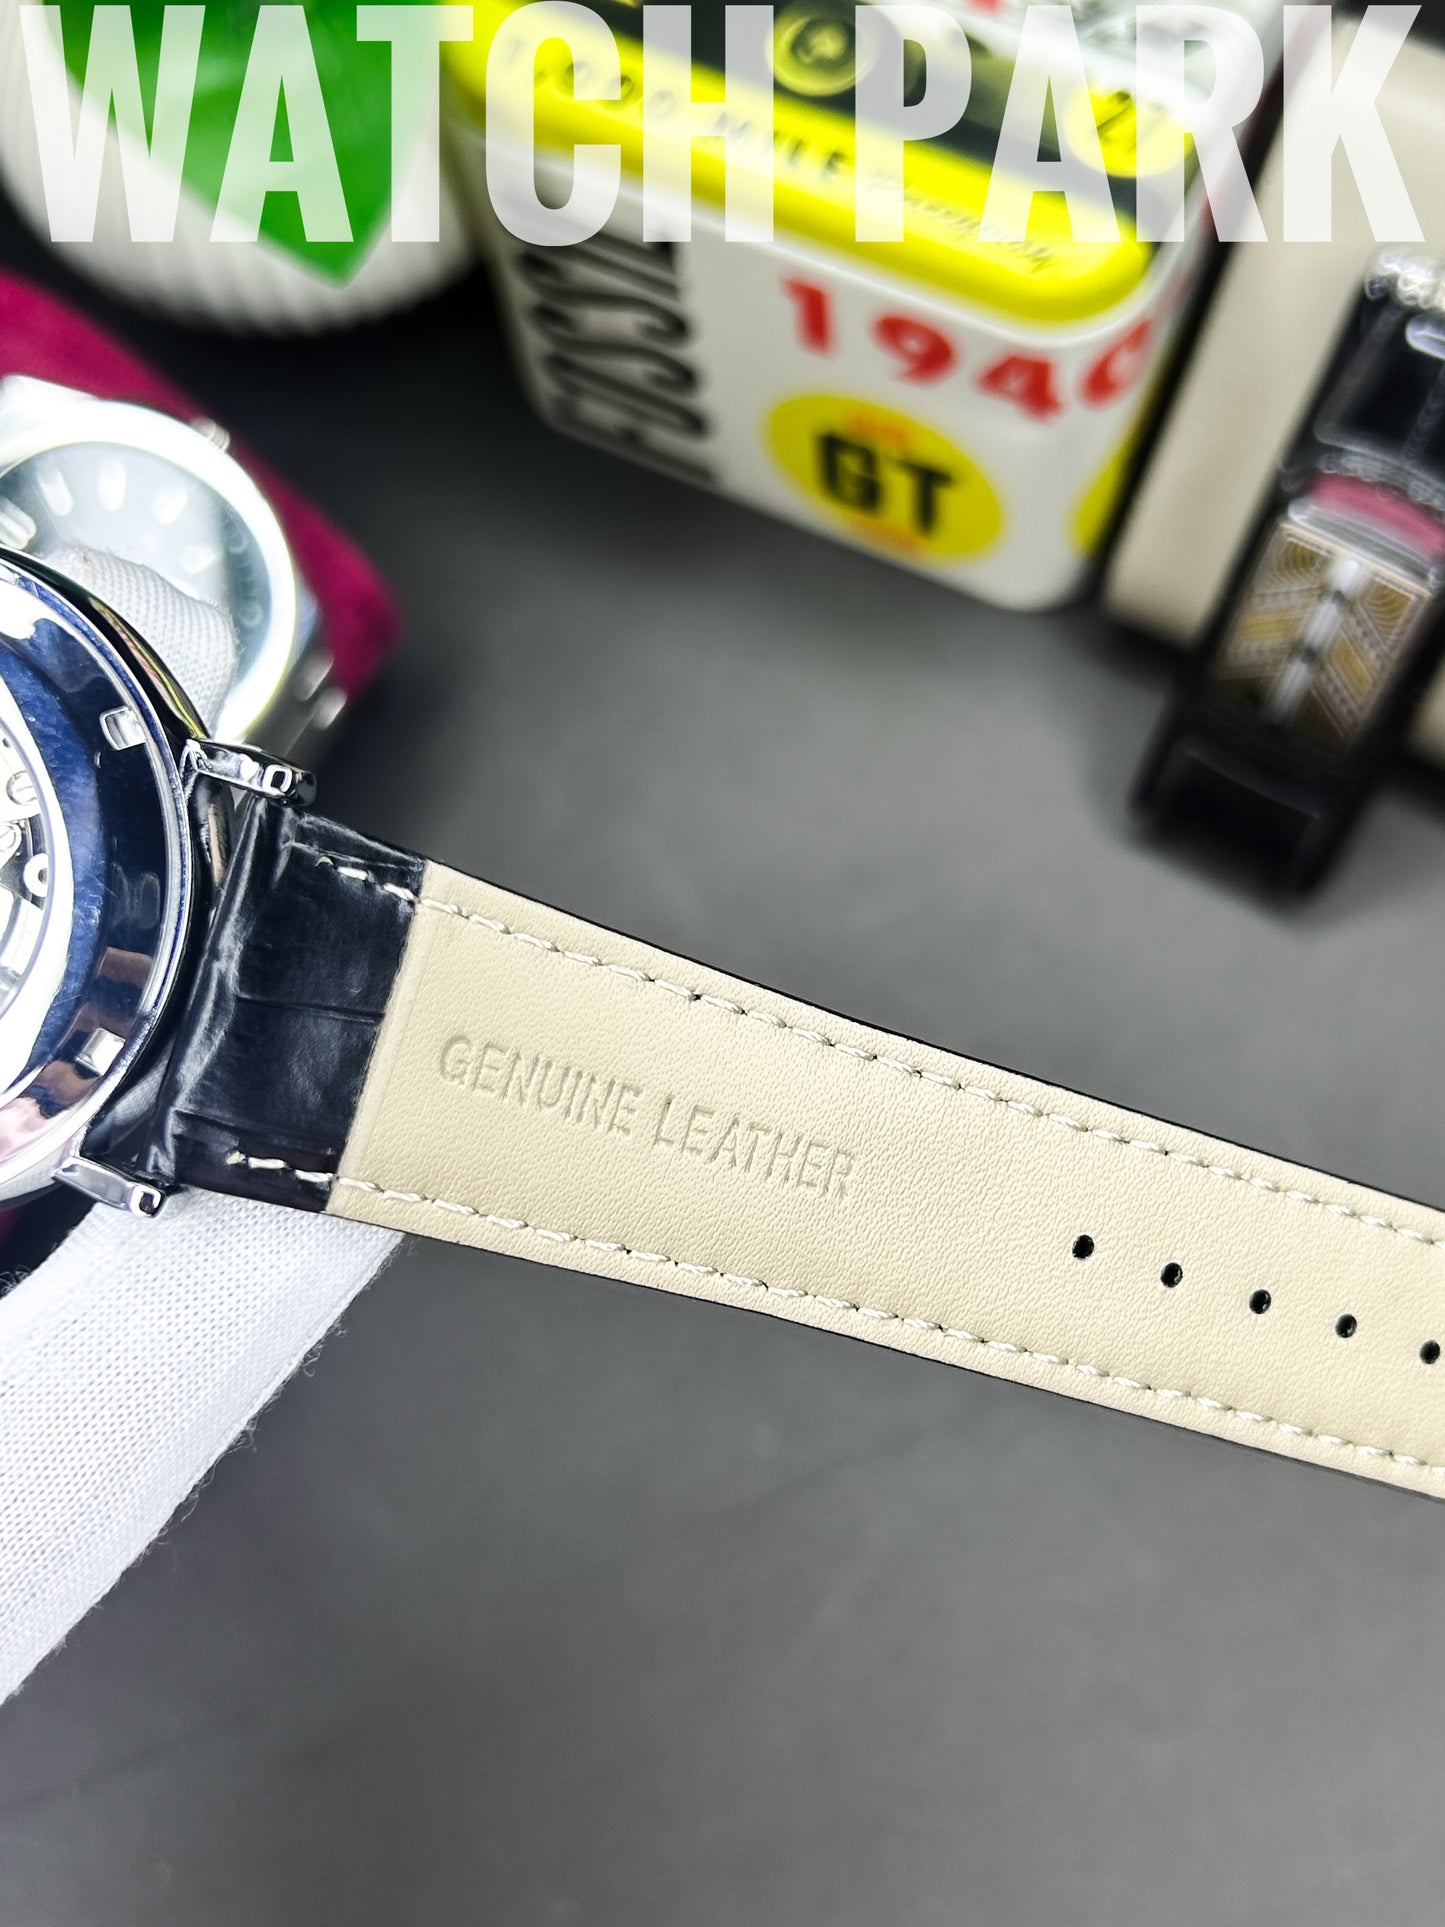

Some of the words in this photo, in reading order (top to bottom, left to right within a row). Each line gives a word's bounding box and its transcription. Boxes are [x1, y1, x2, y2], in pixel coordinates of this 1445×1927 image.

[812, 428, 958, 540] GT
[438, 1033, 644, 1137] GENUINE
[652, 1094, 859, 1199] LEATHER
